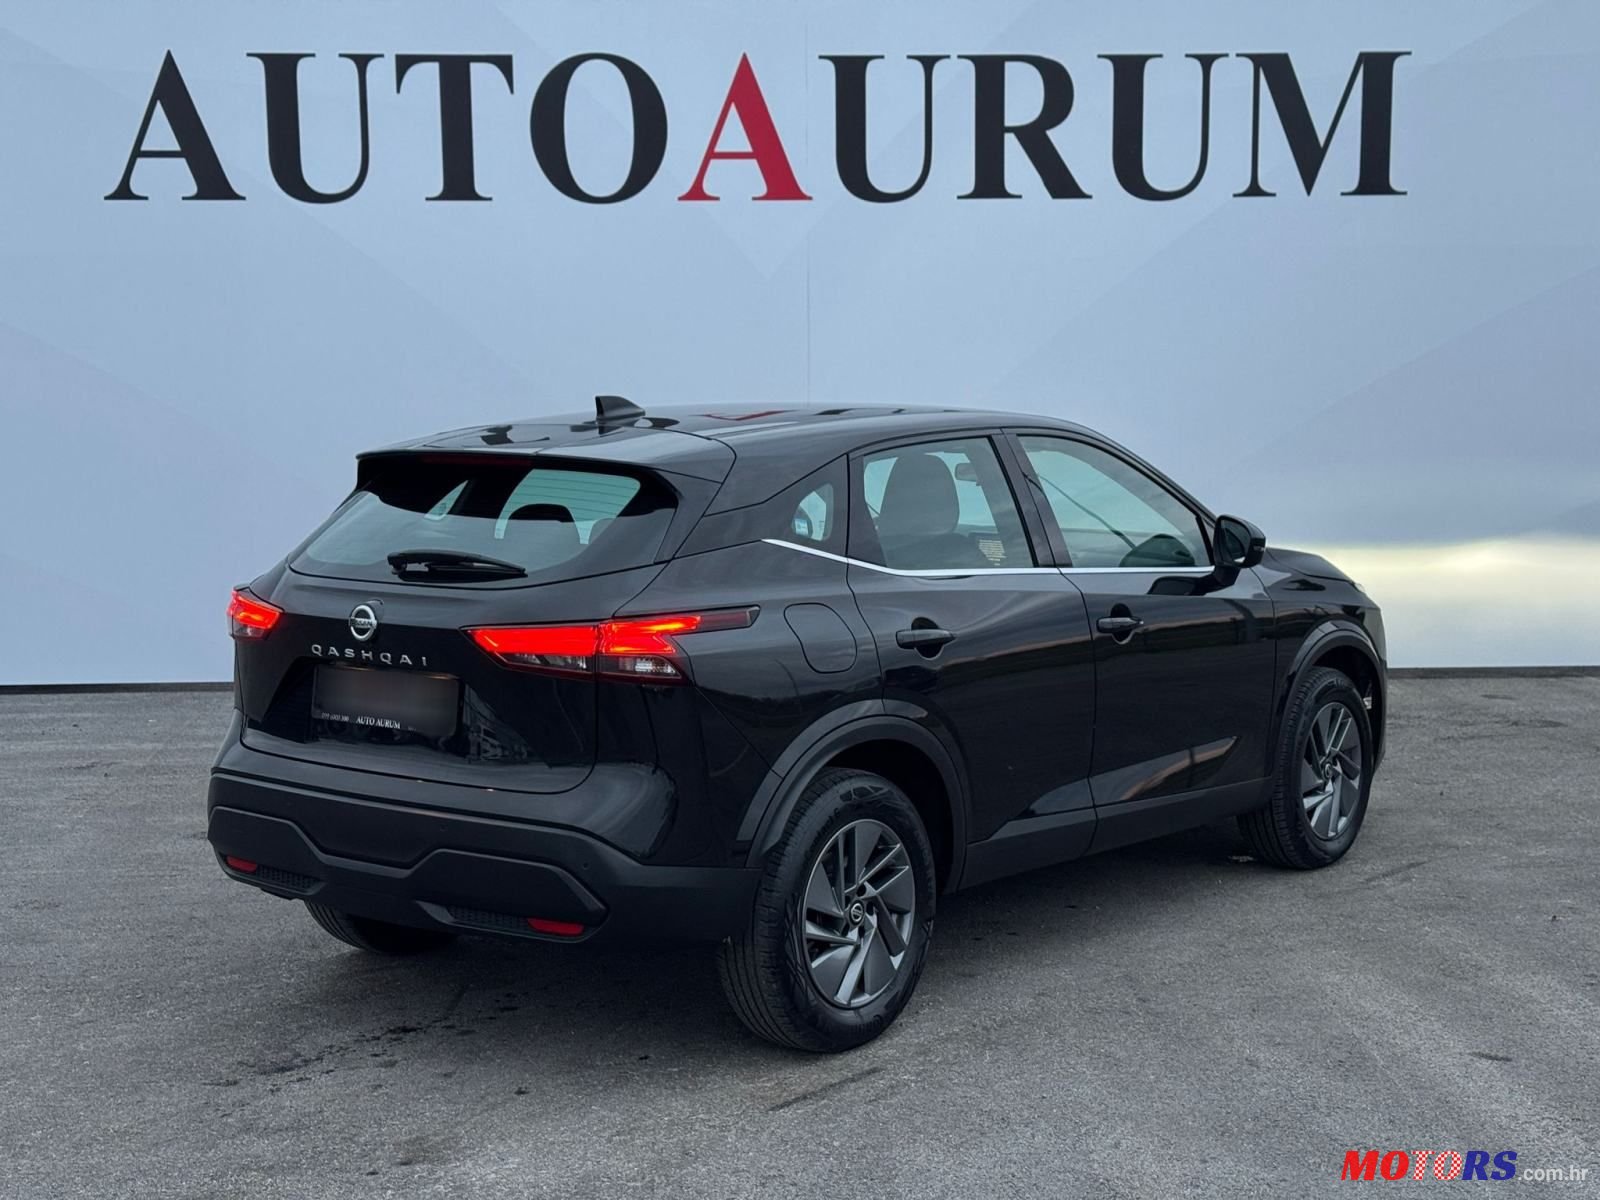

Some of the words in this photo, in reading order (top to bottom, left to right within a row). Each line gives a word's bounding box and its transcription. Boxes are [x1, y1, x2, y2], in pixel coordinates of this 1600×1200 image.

[311, 643, 428, 667] QASHQAI
[355, 715, 375, 726] AUTO
[375, 718, 401, 729] AURUM
